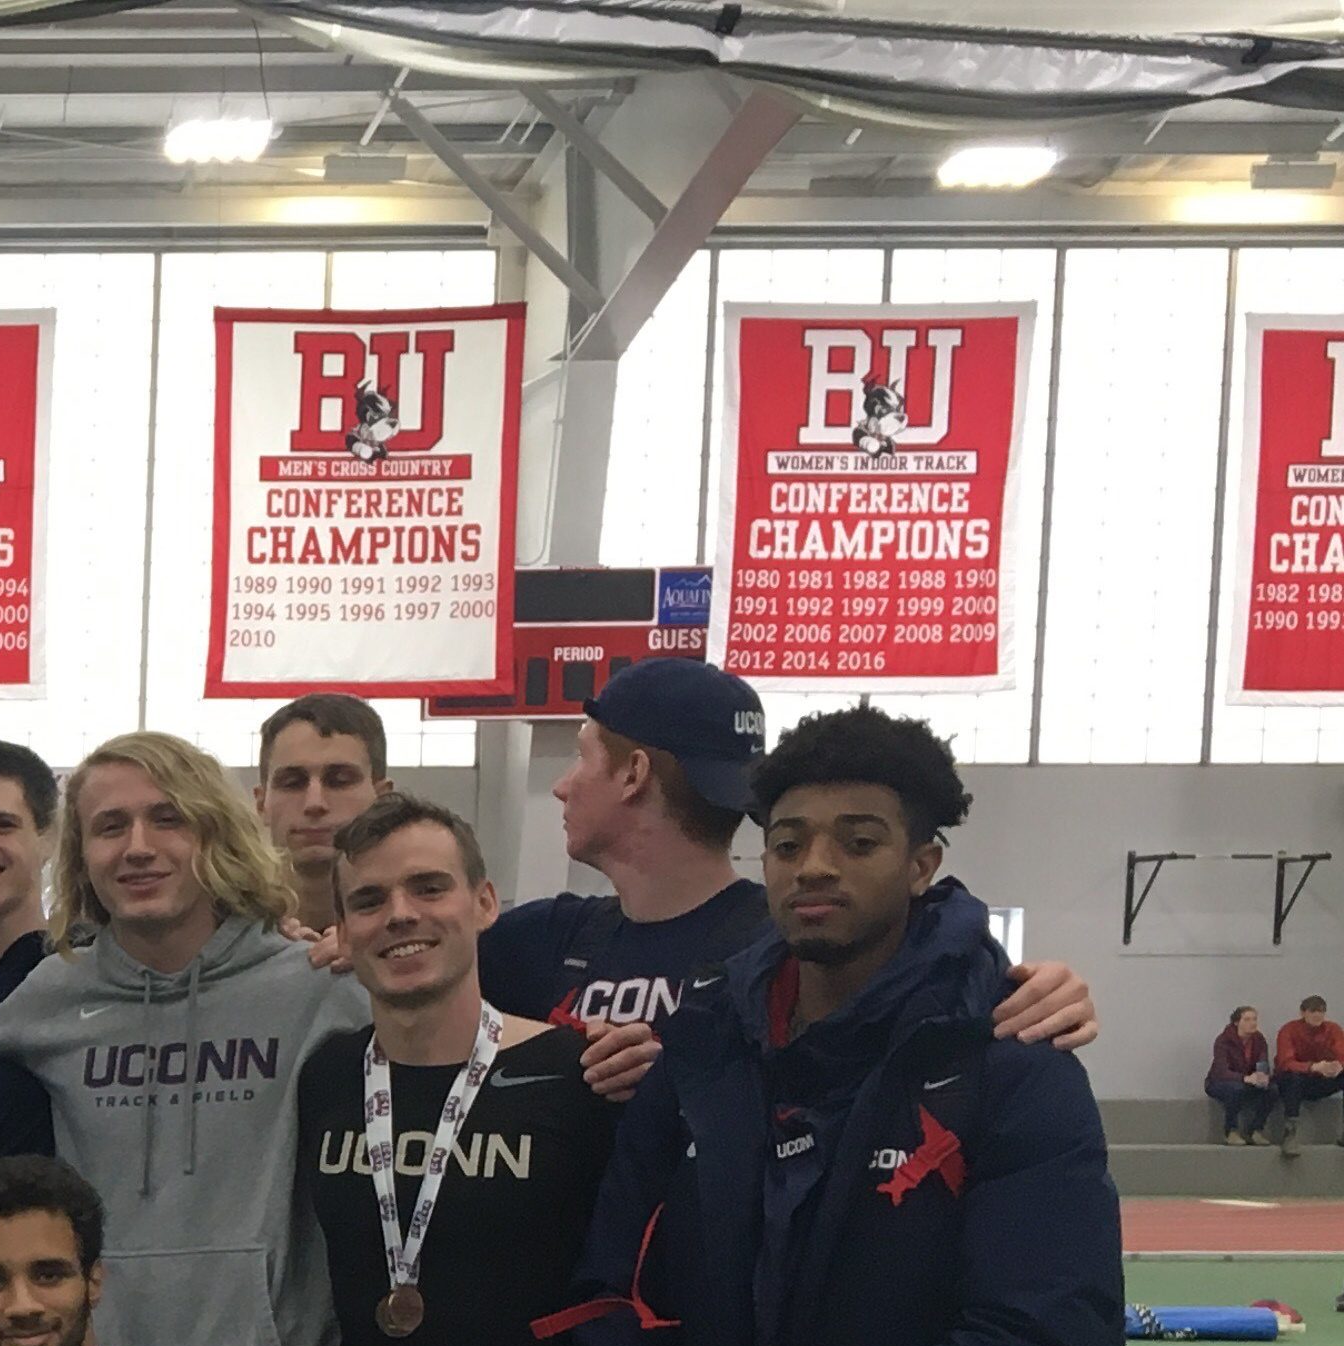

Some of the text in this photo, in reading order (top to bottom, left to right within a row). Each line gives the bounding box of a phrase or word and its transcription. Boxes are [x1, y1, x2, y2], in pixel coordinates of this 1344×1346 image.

[291, 330, 454, 451] BU
[798, 328, 963, 444] BU
[279, 460, 452, 476] MEN'S CROSS COUNTRY
[775, 455, 967, 471] WOMEN'S INDOOR TRACK
[267, 487, 463, 518] CONFERENCE
[770, 482, 969, 513] CONFERENCE
[247, 524, 481, 565] CHAMPIONS
[749, 519, 990, 559] CHAMPIONS
[234, 573, 494, 594] 1989 1990 1991 1992 1993
[736, 569, 779, 588] 1980
[787, 569, 833, 588] 1981
[842, 569, 889, 588] 1982
[898, 569, 945, 588] 1988
[1256, 584, 1344, 603] 1982 198
[232, 600, 494, 621] 1994 1995 1996 1997 2000
[735, 597, 778, 616] 1991
[786, 597, 832, 616] 1992
[841, 597, 888, 616] 1997
[896, 597, 943, 616] 1999
[1254, 611, 1298, 630] 1990
[229, 629, 275, 648] 2010
[730, 622, 995, 643] 2002 2006 2007 2008 2009
[554, 646, 603, 662] PERIOD
[728, 652, 885, 670] 2012 2014 2016
[83, 1037, 280, 1088] UCONN
[95, 1092, 159, 1108] TRACK
[191, 1089, 256, 1104] FIELD
